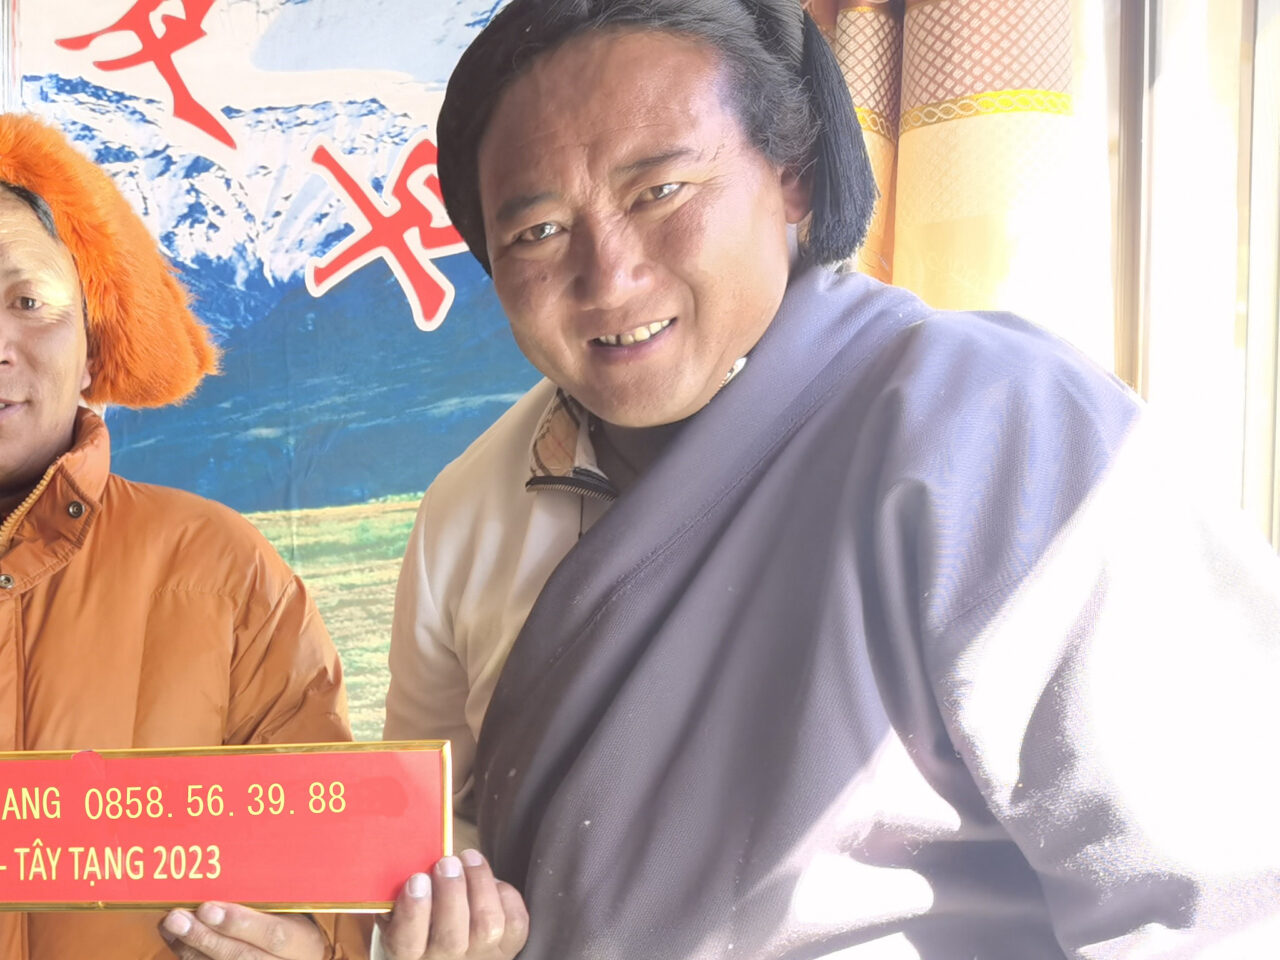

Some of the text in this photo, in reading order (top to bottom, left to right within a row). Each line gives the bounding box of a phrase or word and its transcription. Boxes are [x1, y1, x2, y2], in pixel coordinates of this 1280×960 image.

[84, 786, 173, 820] 0858.
[186, 784, 234, 817] 56.
[247, 783, 295, 816] 39.
[308, 781, 346, 814] 88
[14, 838, 62, 881] TÂY
[68, 846, 144, 887] TẠNG
[153, 845, 221, 880] 2023
